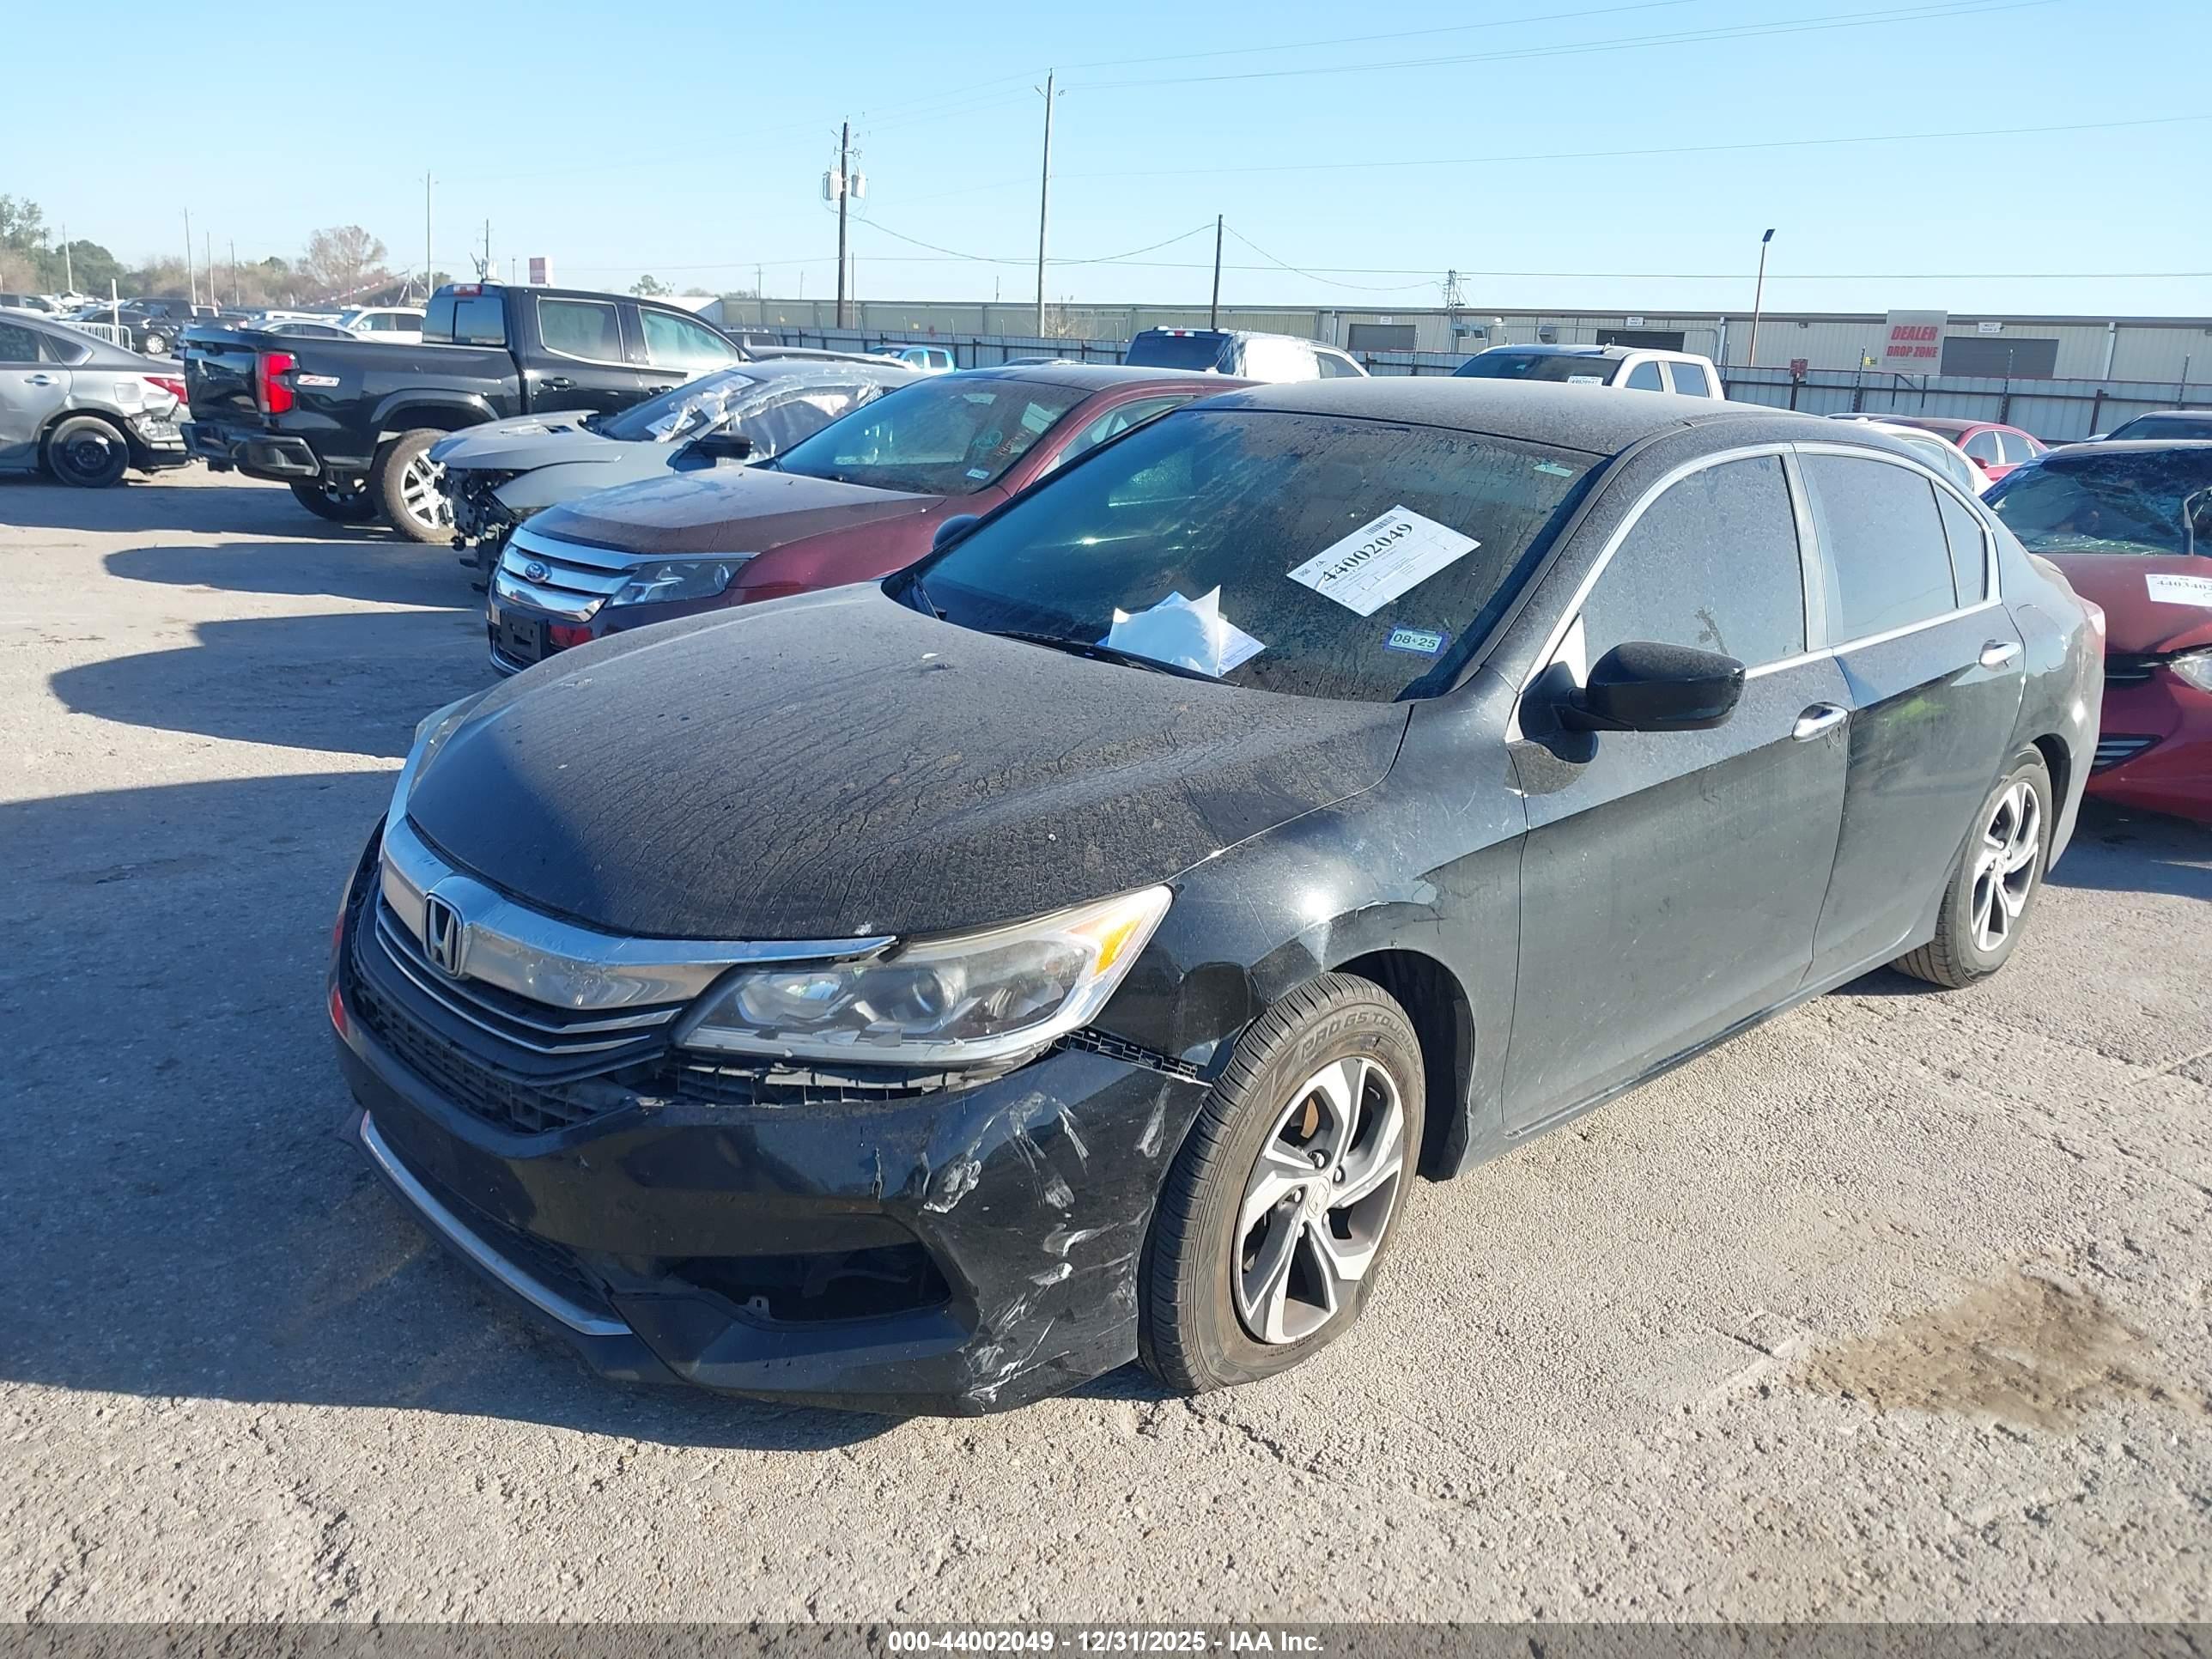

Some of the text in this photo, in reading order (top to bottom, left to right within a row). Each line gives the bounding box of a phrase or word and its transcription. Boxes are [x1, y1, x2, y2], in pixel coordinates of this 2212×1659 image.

[1891, 325, 1938, 341] DEALER
[1887, 345, 1938, 358] DROP ZONE
[1323, 523, 1413, 582] 44002049
[1393, 634, 1437, 648] 08 25
